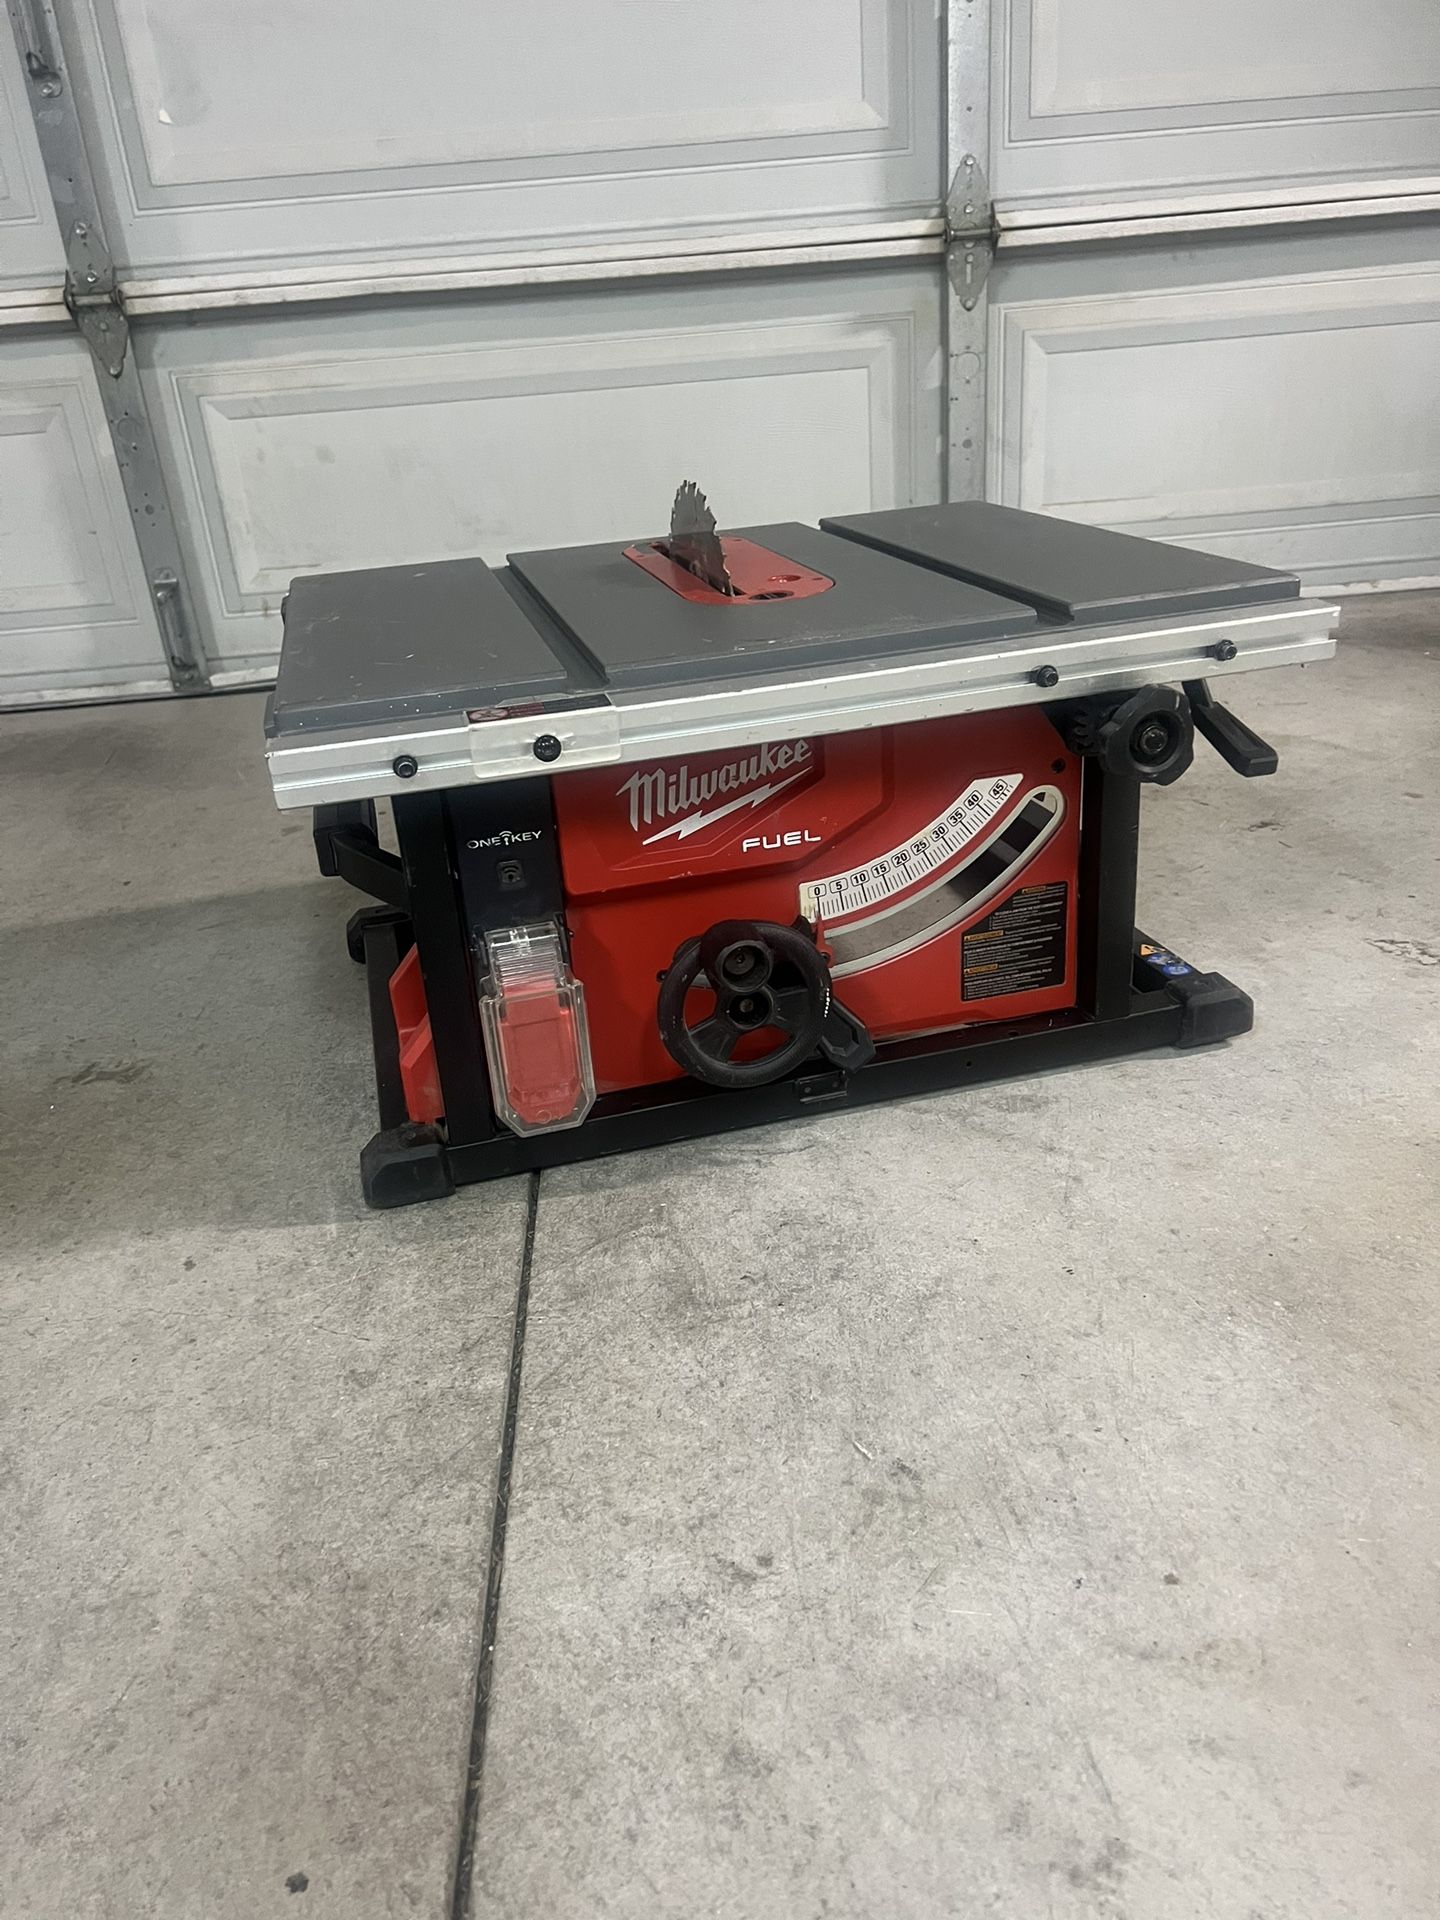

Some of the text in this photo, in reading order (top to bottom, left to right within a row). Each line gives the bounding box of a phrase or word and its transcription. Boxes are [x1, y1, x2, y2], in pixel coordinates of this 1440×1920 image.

[615, 740, 812, 832] Milwaukee
[742, 829, 821, 852] FUEL
[814, 783, 1004, 896] 0 5 10 15 20 25 30 35 40 45
